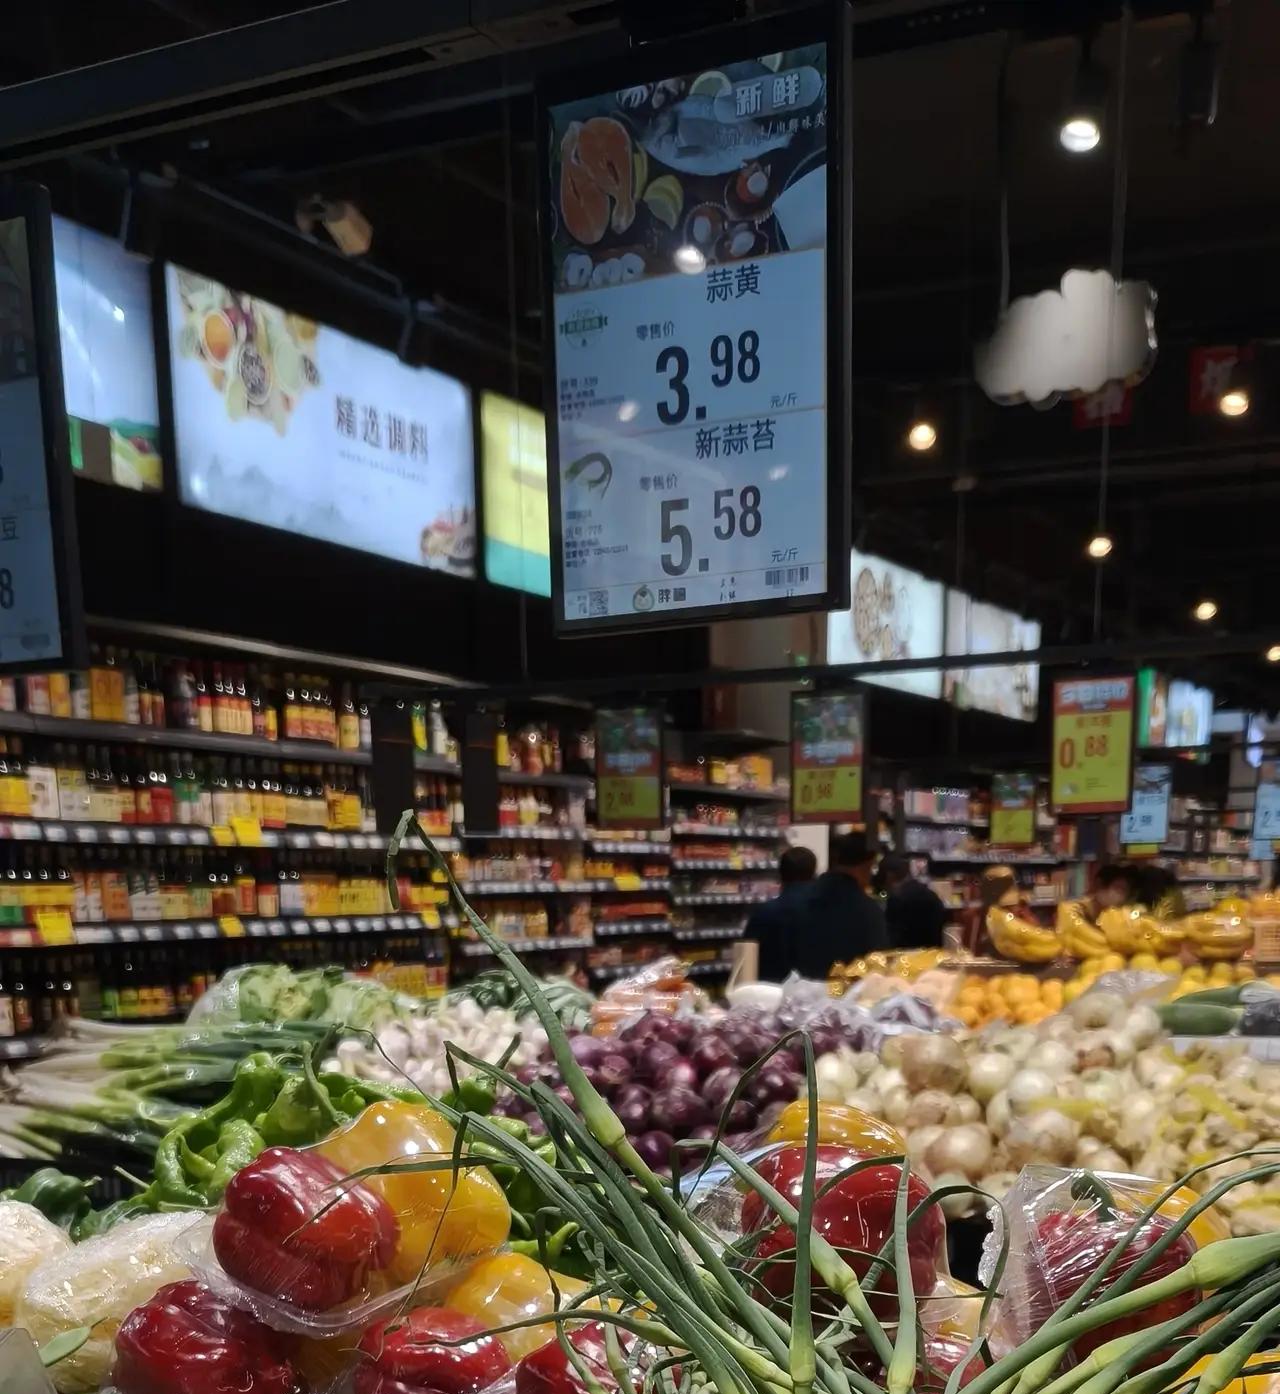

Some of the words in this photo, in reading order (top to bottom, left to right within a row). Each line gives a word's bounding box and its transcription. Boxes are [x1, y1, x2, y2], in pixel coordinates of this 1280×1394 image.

[736, 72, 800, 117] 新鲜
[706, 263, 761, 304] 蒜黄
[636, 321, 675, 341] 零售价
[770, 391, 798, 409] 元/斤
[335, 393, 428, 465] 精选调料
[695, 418, 777, 460] 新蒜苔
[639, 474, 679, 493] 零售价
[771, 546, 799, 563] 元/斤
